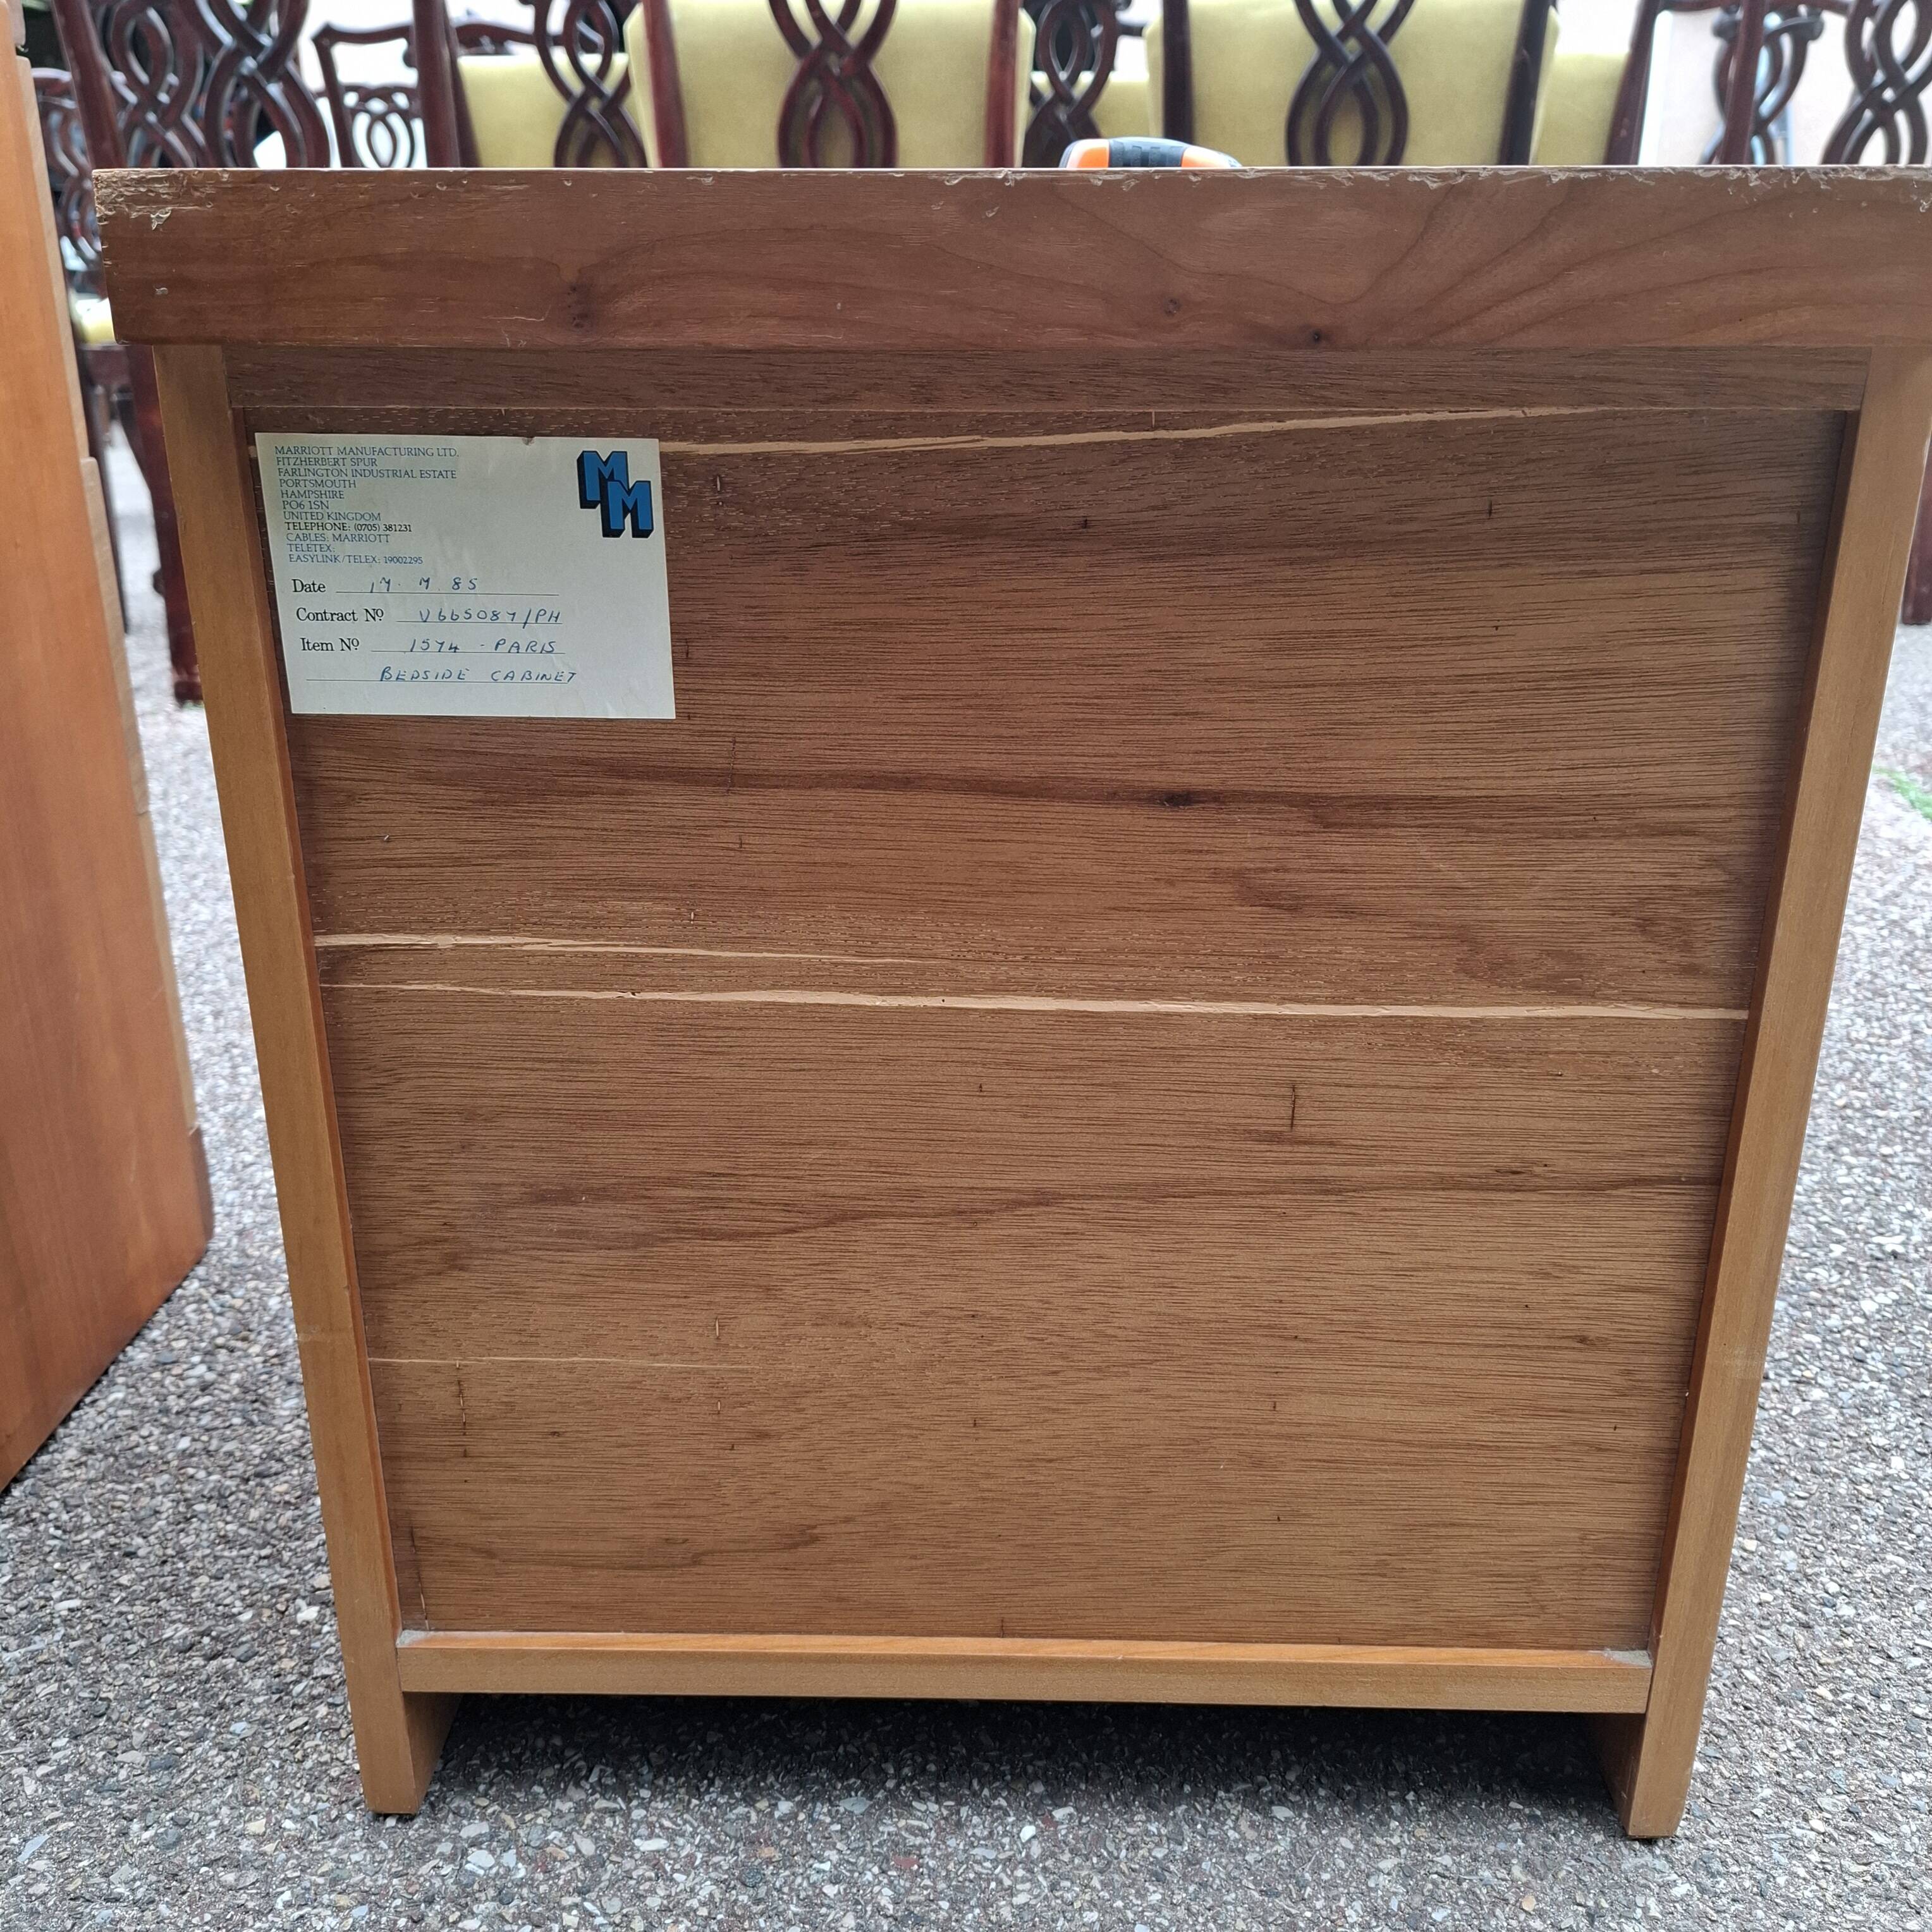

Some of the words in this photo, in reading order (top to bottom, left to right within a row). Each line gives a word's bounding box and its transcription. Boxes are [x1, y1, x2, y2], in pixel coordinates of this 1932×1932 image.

[275, 446, 333, 455] MARRIOTT
[337, 446, 434, 456] MANUFACTURING
[437, 448, 459, 457] LTD.
[276, 456, 347, 466] FITZHERBERT
[350, 458, 377, 467] SPUR
[278, 468, 348, 477] FARLINGTON
[352, 469, 417, 478] INDUSTRIAL
[419, 470, 456, 479] ESTATE
[279, 479, 356, 488] PORTSMOUTH
[281, 489, 345, 499] HAMPSHIRE
[283, 500, 305, 510] PO6
[308, 500, 329, 510] 1SN
[283, 511, 323, 520] UNITED
[327, 512, 381, 521] KINGDOM
[284, 522, 350, 531] TELEPHONE:
[354, 523, 381, 532] (0705)
[383, 524, 412, 532] 381231
[286, 533, 329, 542] CABLES:
[332, 534, 391, 542] MARRIOTT
[286, 544, 335, 553] TELETEX:
[291, 578, 326, 593] Date
[296, 607, 358, 621] Contract
[300, 637, 334, 651] Item
[494, 638, 556, 654] PARIS
[381, 666, 470, 682] BEDSIDE
[491, 670, 577, 683] CABINET
